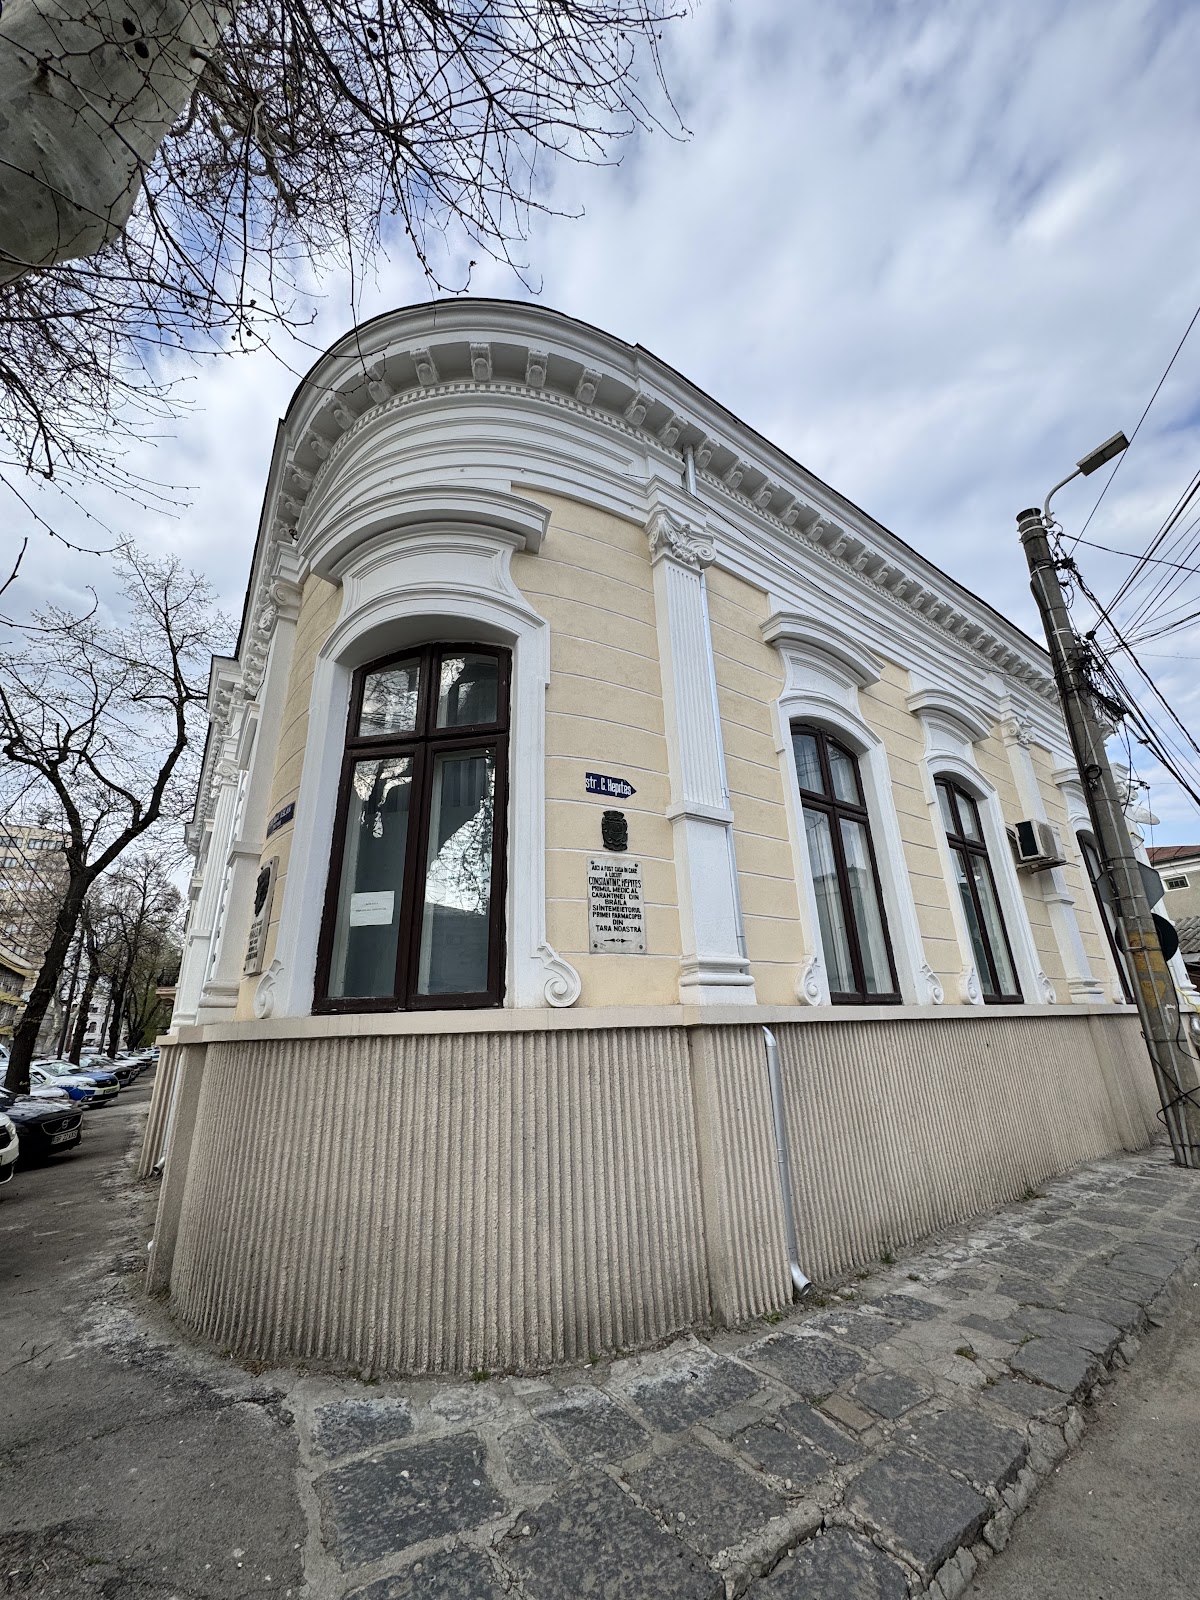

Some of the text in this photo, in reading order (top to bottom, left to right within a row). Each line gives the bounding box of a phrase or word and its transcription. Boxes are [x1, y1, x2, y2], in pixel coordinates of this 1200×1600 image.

[607, 778, 631, 797] Hepites
[588, 877, 616, 886] CONSTANTIN
[621, 879, 642, 889] HEPITES
